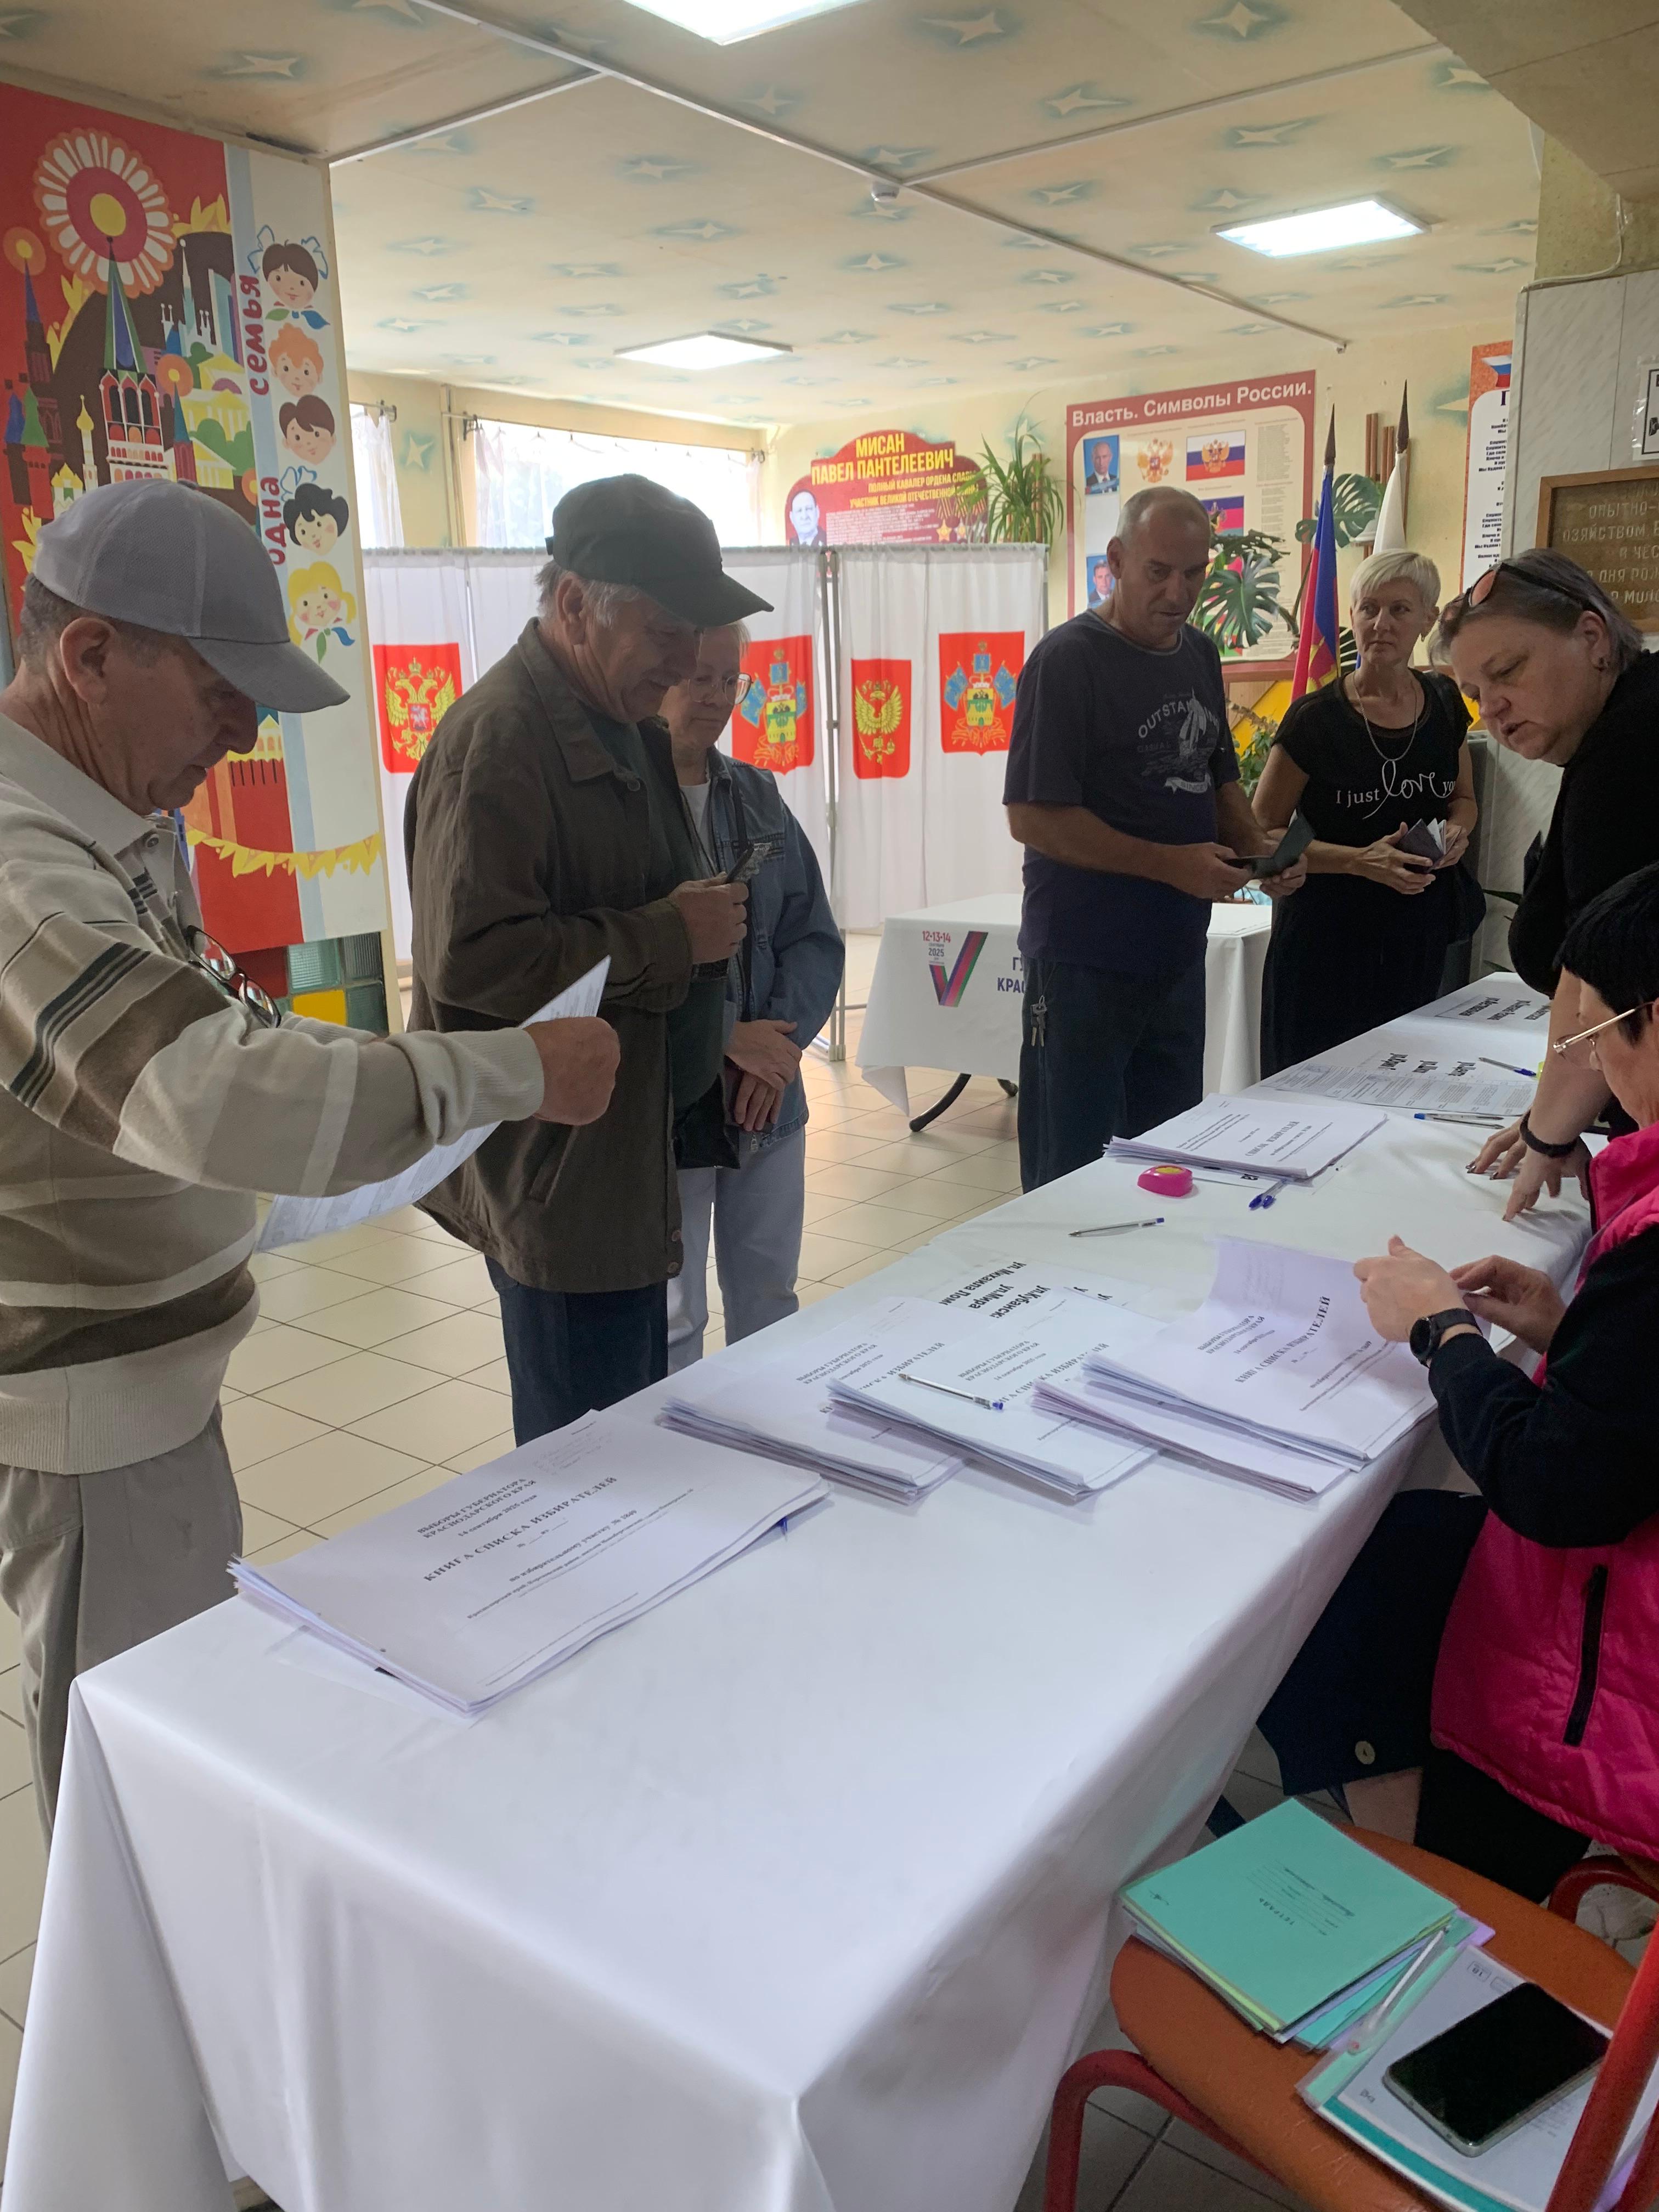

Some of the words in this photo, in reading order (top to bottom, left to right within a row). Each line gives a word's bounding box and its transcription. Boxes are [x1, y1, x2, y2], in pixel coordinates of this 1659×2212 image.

[239, 274, 269, 395] семья
[1073, 405, 1138, 427] Власть.
[1143, 392, 1231, 417] Символы
[1237, 381, 1312, 404] России.
[856, 433, 905, 458] МИСАН
[811, 461, 854, 486] ПАВЕЛ
[857, 448, 953, 480] ПАНТЕЛЕЕВИЧ
[868, 480, 896, 493] ПОЛНЫЙ
[896, 476, 925, 490] КАВАЛЕР
[925, 473, 952, 487] ОРДЕНА
[907, 486, 955, 501] ОТЕЧЕСТВЕННОЙ
[1336, 790, 1341, 804] I
[1347, 788, 1380, 808] just
[1363, 759, 1453, 819] love
[928, 947, 944, 957] 2025
[964, 1268, 1015, 1291] Михаила
[968, 1284, 1014, 1309] ул.Мира
[417, 1511, 460, 1534] ВЫБОРЫ
[459, 1479, 526, 1515] ГУБЕРНАТОРА
[423, 1493, 512, 1538] КРАСНОДАРСКОГО
[509, 1480, 537, 1497] КРАЯ
[424, 1552, 474, 1582] КНИГА
[474, 1524, 531, 1554] СПИСКА
[529, 1476, 617, 1525] ИЗБИРАТЕЛЕЙ
[1259, 1898, 1295, 1925] ТЕТРАДЬ
